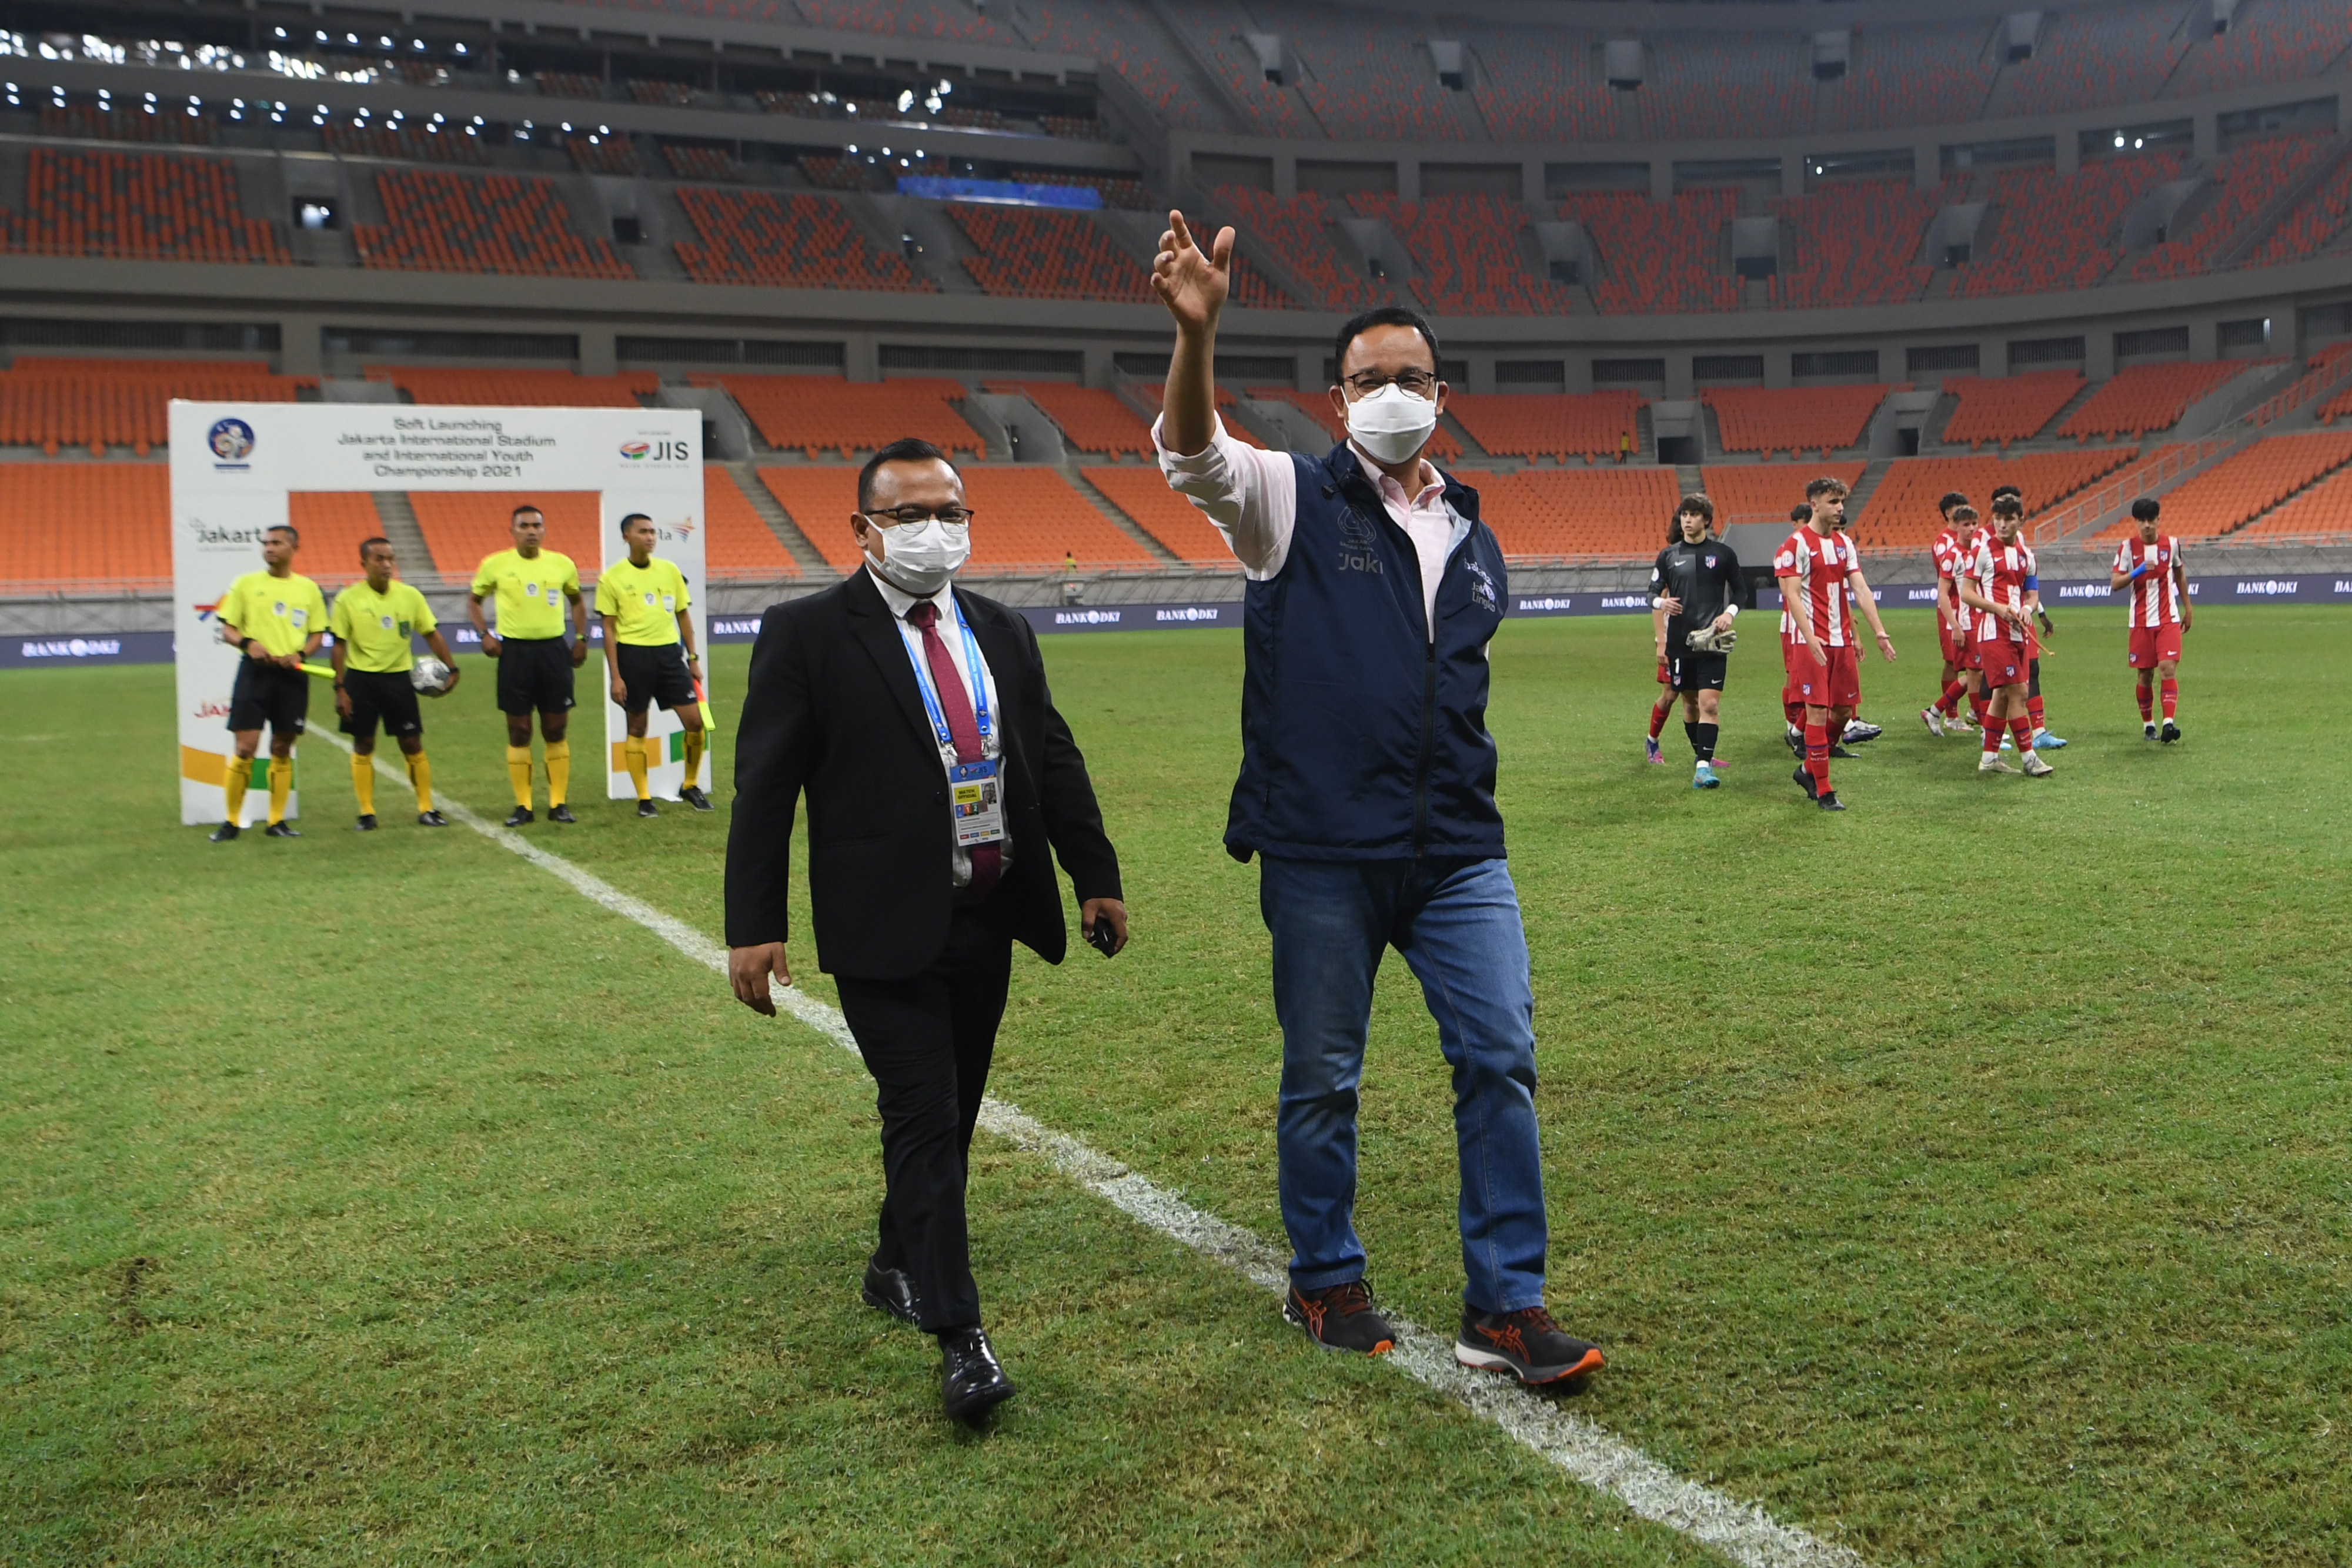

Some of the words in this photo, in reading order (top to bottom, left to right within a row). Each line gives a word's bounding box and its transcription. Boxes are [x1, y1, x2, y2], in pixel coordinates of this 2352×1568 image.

[393, 417, 425, 431] Soft
[429, 418, 502, 434] Launching
[338, 434, 396, 446] Jakarta
[399, 434, 493, 446] International
[497, 435, 556, 447] Stadium
[363, 450, 390, 461] and
[394, 450, 487, 462] International
[492, 450, 533, 462] Youth
[653, 442, 689, 461] JIS
[374, 465, 478, 479] Championship
[482, 466, 522, 477] 2021
[197, 524, 265, 543] Jakart
[2060, 587, 2085, 597] BANK
[2094, 586, 2112, 596] DKI
[2236, 582, 2267, 594] BANK
[2277, 581, 2298, 593] DKI
[1909, 590, 1930, 600] BANK
[1519, 600, 1545, 610] BANK
[1554, 599, 1571, 609] DKI
[1601, 597, 1627, 607] BANK
[1055, 612, 1088, 624] BANK
[1100, 611, 1121, 623] DKI
[1156, 609, 1188, 621] BANK
[1198, 608, 1218, 619] DKI
[713, 621, 751, 634] BANK
[1675, 658, 1680, 674] 1
